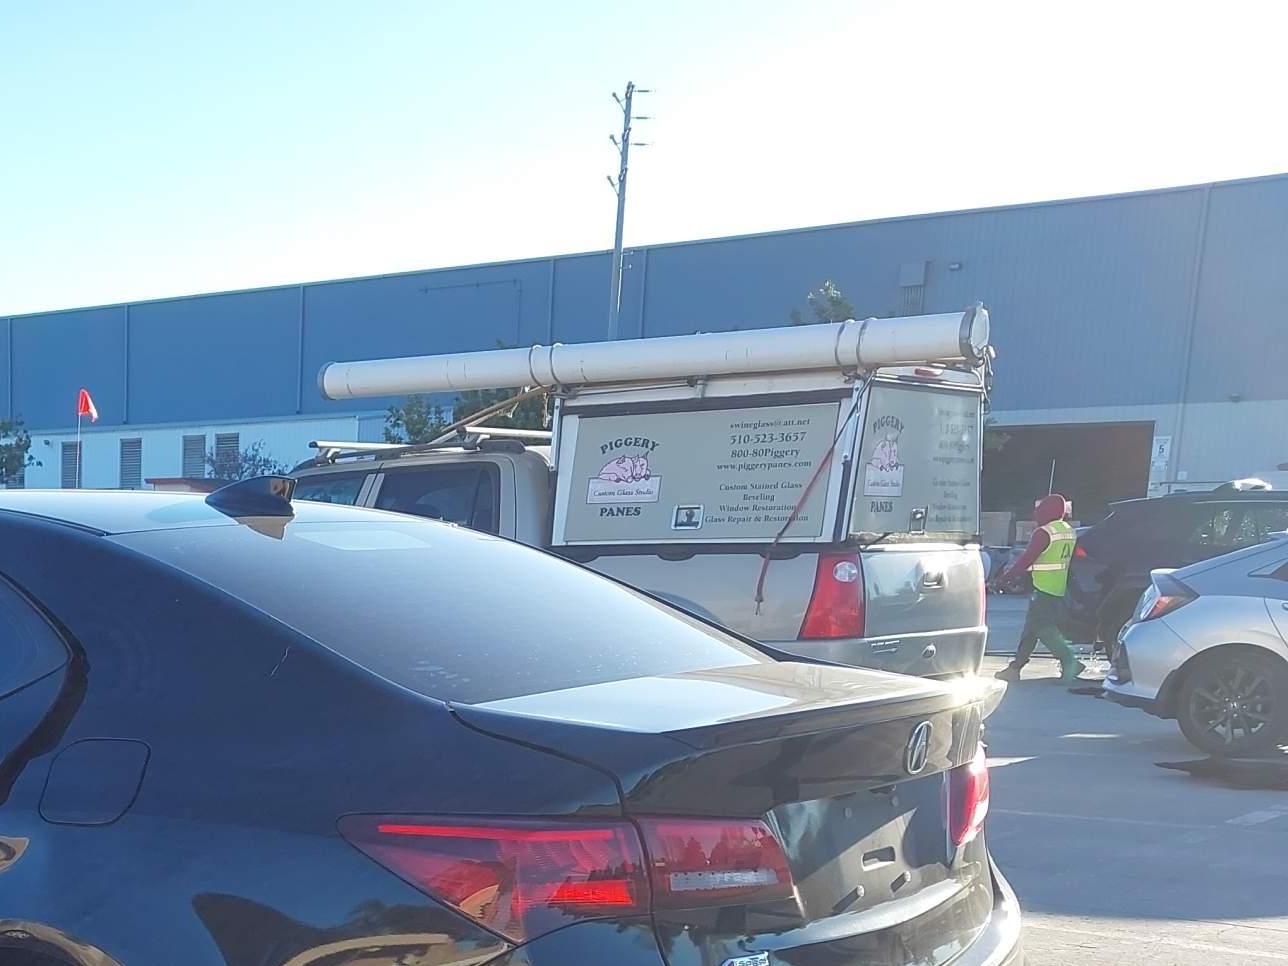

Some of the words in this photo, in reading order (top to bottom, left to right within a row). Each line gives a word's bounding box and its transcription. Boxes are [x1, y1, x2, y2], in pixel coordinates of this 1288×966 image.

[873, 415, 904, 433] PIGGERY
[730, 432, 807, 444] 510-523-3657
[600, 437, 660, 454] PIGGERY
[730, 448, 800, 459] 800-80Piggery
[716, 461, 812, 472] www.piggerypanes.com
[719, 483, 748, 491] Custom
[750, 481, 779, 490] Stained
[780, 480, 803, 489] Glass
[743, 493, 775, 502] Beveling
[599, 506, 641, 517] PANES
[719, 504, 749, 512] Window
[870, 501, 893, 513] PANES
[705, 515, 725, 523] Glass
[727, 514, 752, 524] Repair
